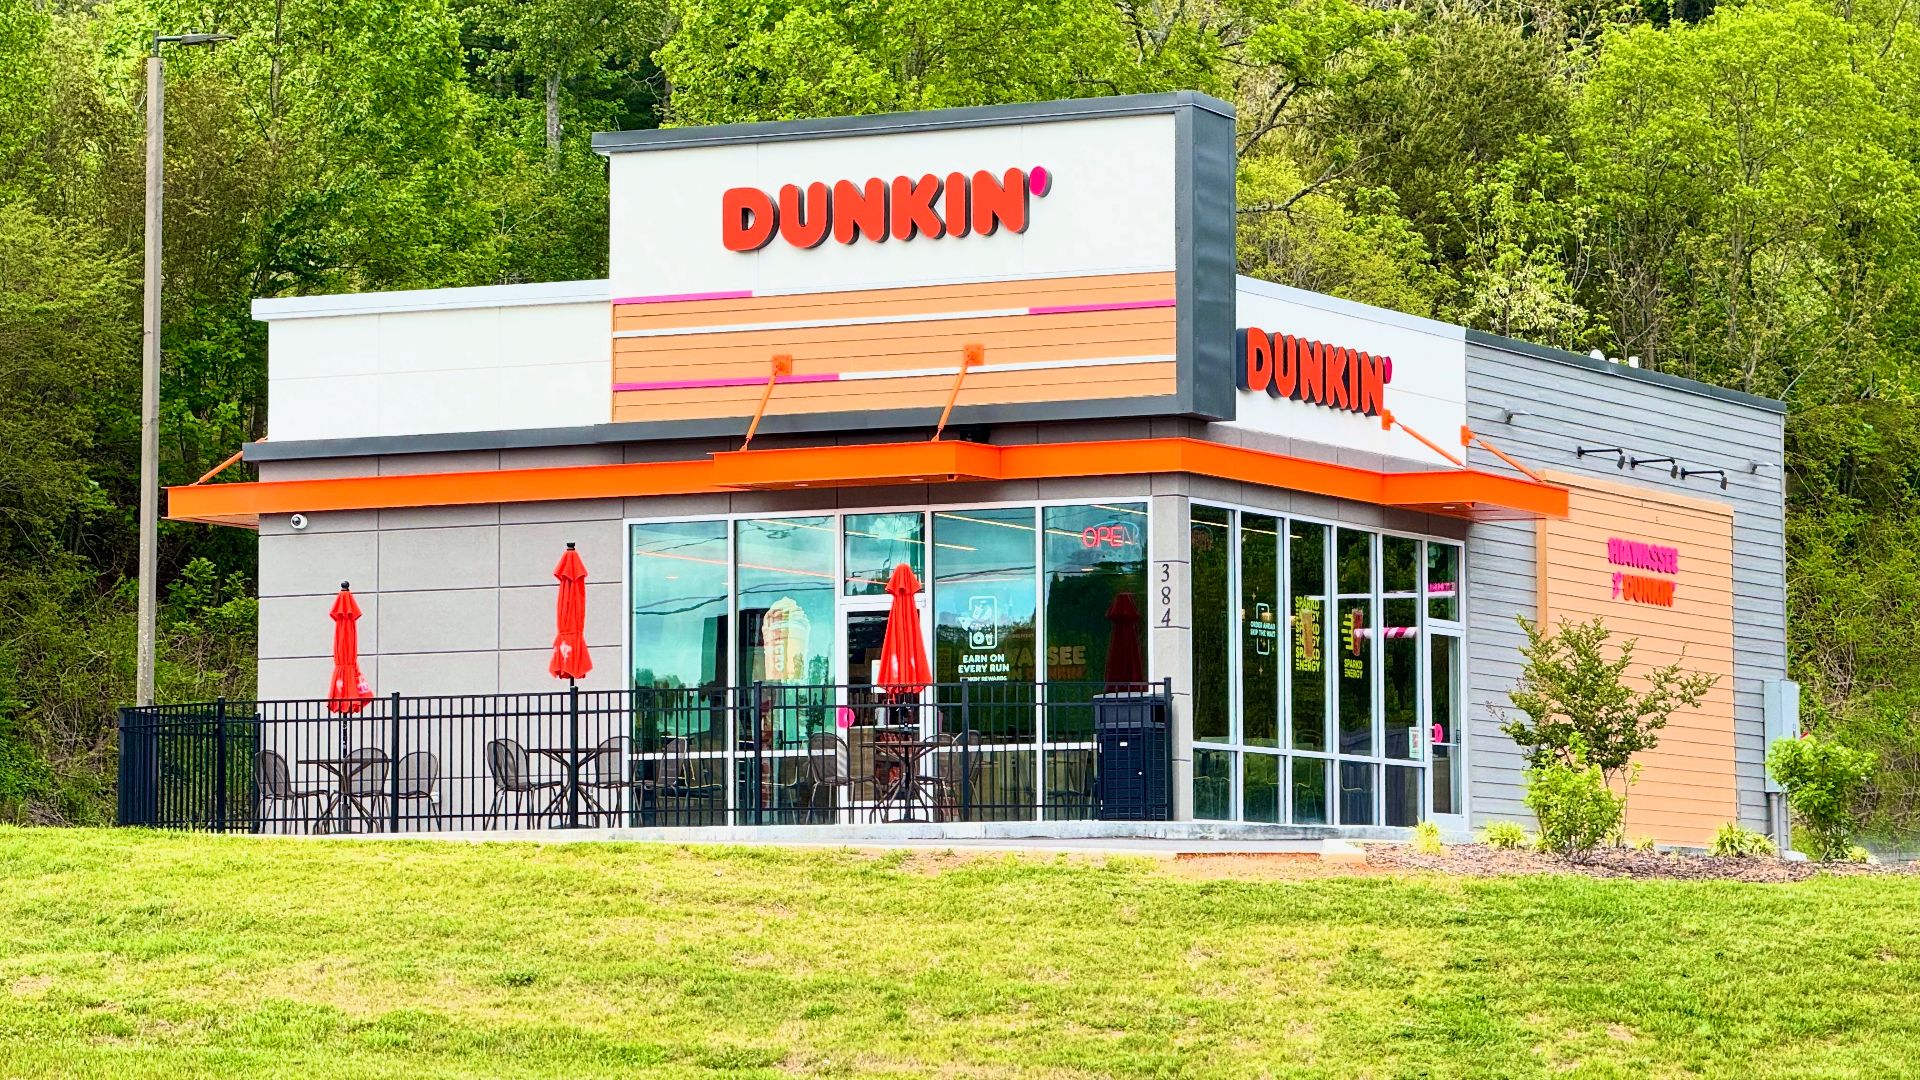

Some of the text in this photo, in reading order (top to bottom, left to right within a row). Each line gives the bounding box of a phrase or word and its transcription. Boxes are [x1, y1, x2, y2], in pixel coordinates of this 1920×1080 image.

[722, 165, 1051, 252] DUNKIN'
[1238, 326, 1393, 417] DUNKIN'
[1082, 526, 1136, 548] OPEN
[1160, 563, 1171, 627] 384
[957, 663, 1010, 674] EVERY RUN
[962, 653, 1005, 664] EARN ON
